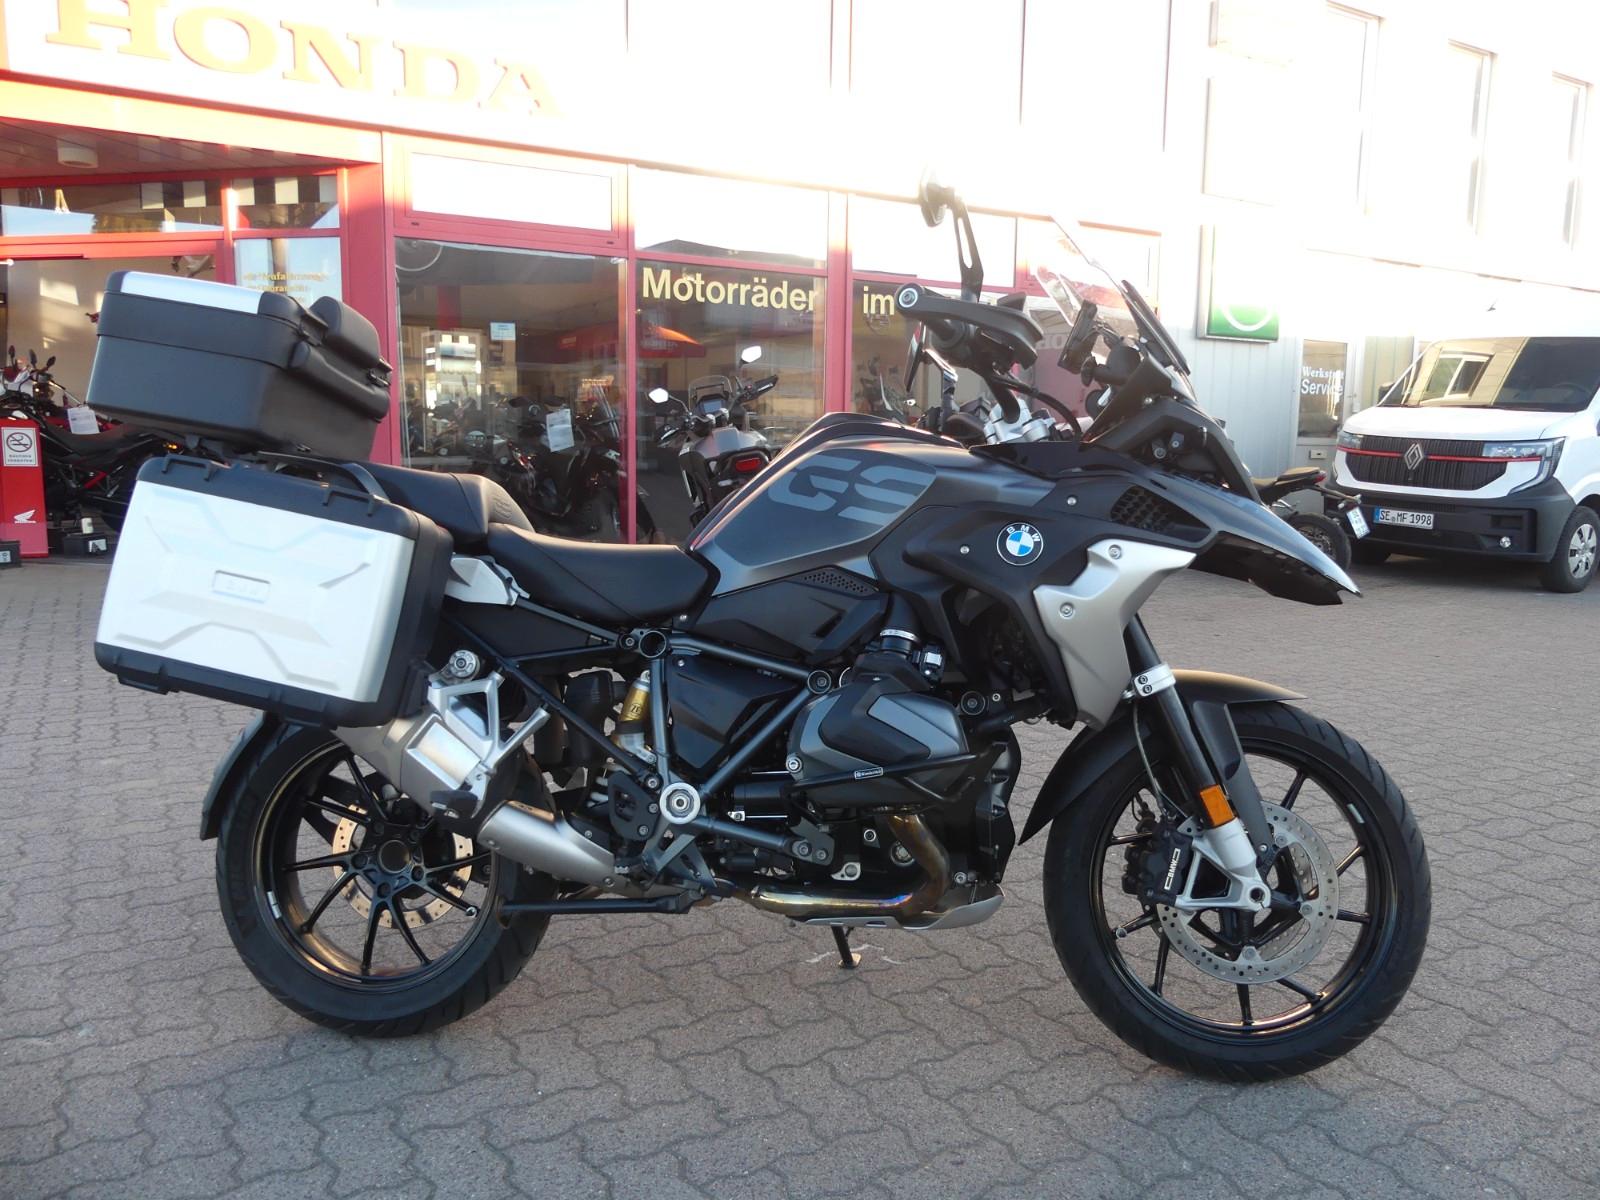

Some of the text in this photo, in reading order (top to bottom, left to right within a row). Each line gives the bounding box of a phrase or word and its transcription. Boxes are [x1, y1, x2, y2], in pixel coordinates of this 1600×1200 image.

[45, 0, 567, 117] HONDA
[641, 267, 895, 316] Motorräder im
[768, 454, 937, 526] GS
[1006, 524, 1041, 542] BMW
[1409, 513, 1432, 526] 1998
